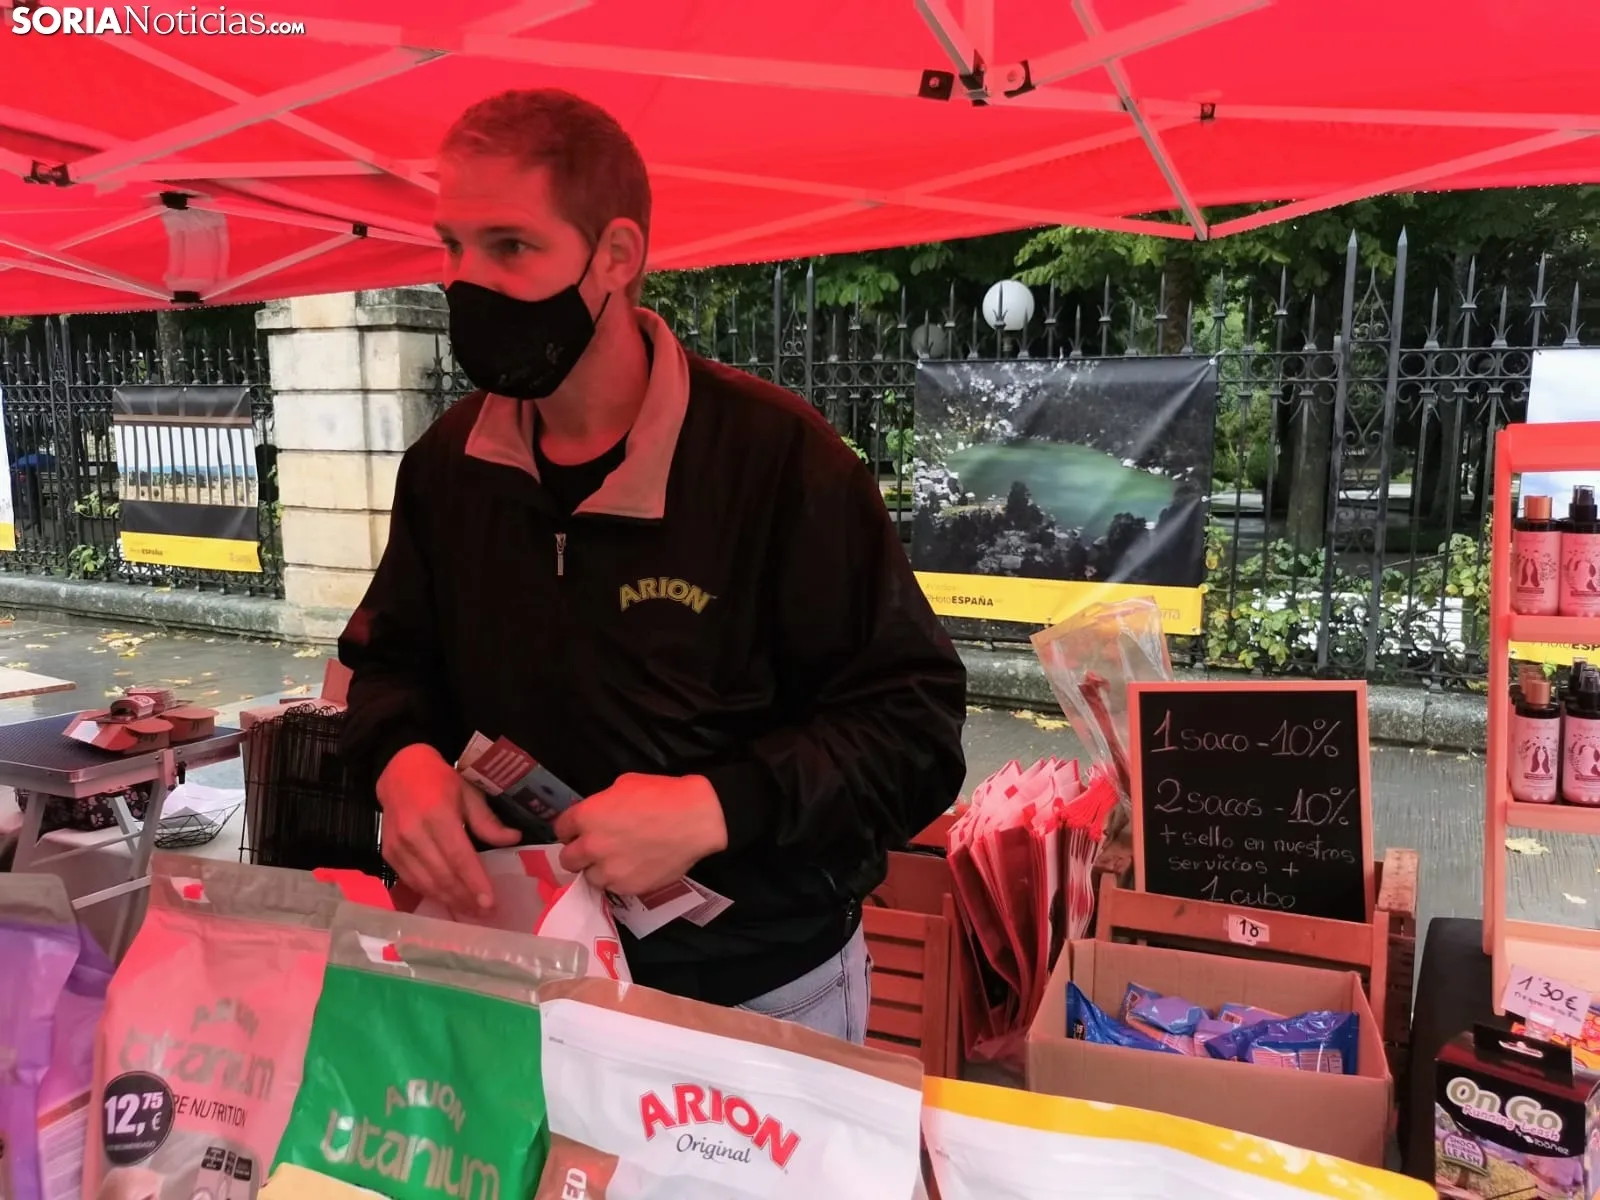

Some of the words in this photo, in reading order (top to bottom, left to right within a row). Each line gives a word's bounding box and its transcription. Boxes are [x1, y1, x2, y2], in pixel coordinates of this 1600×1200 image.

[620, 576, 712, 614] ARION
[1151, 709, 1179, 753] 1
[1181, 728, 1249, 752] saco
[1154, 778, 1183, 813] 2
[1186, 791, 1263, 817] sacos
[1182, 825, 1234, 848] sello
[1244, 837, 1265, 852] en
[1274, 833, 1355, 865] nuestros
[1168, 854, 1268, 875] servicios
[1230, 883, 1296, 909] cubo
[189, 1095, 248, 1129] NUTRITION
[384, 1078, 467, 1134] ARION
[1446, 1076, 1501, 1115] On
[1505, 1095, 1563, 1133] Go
[1462, 1104, 1515, 1131] Running
[1519, 1120, 1561, 1142] Leash
[638, 1082, 802, 1170] ARION
[675, 1132, 752, 1164] Original
